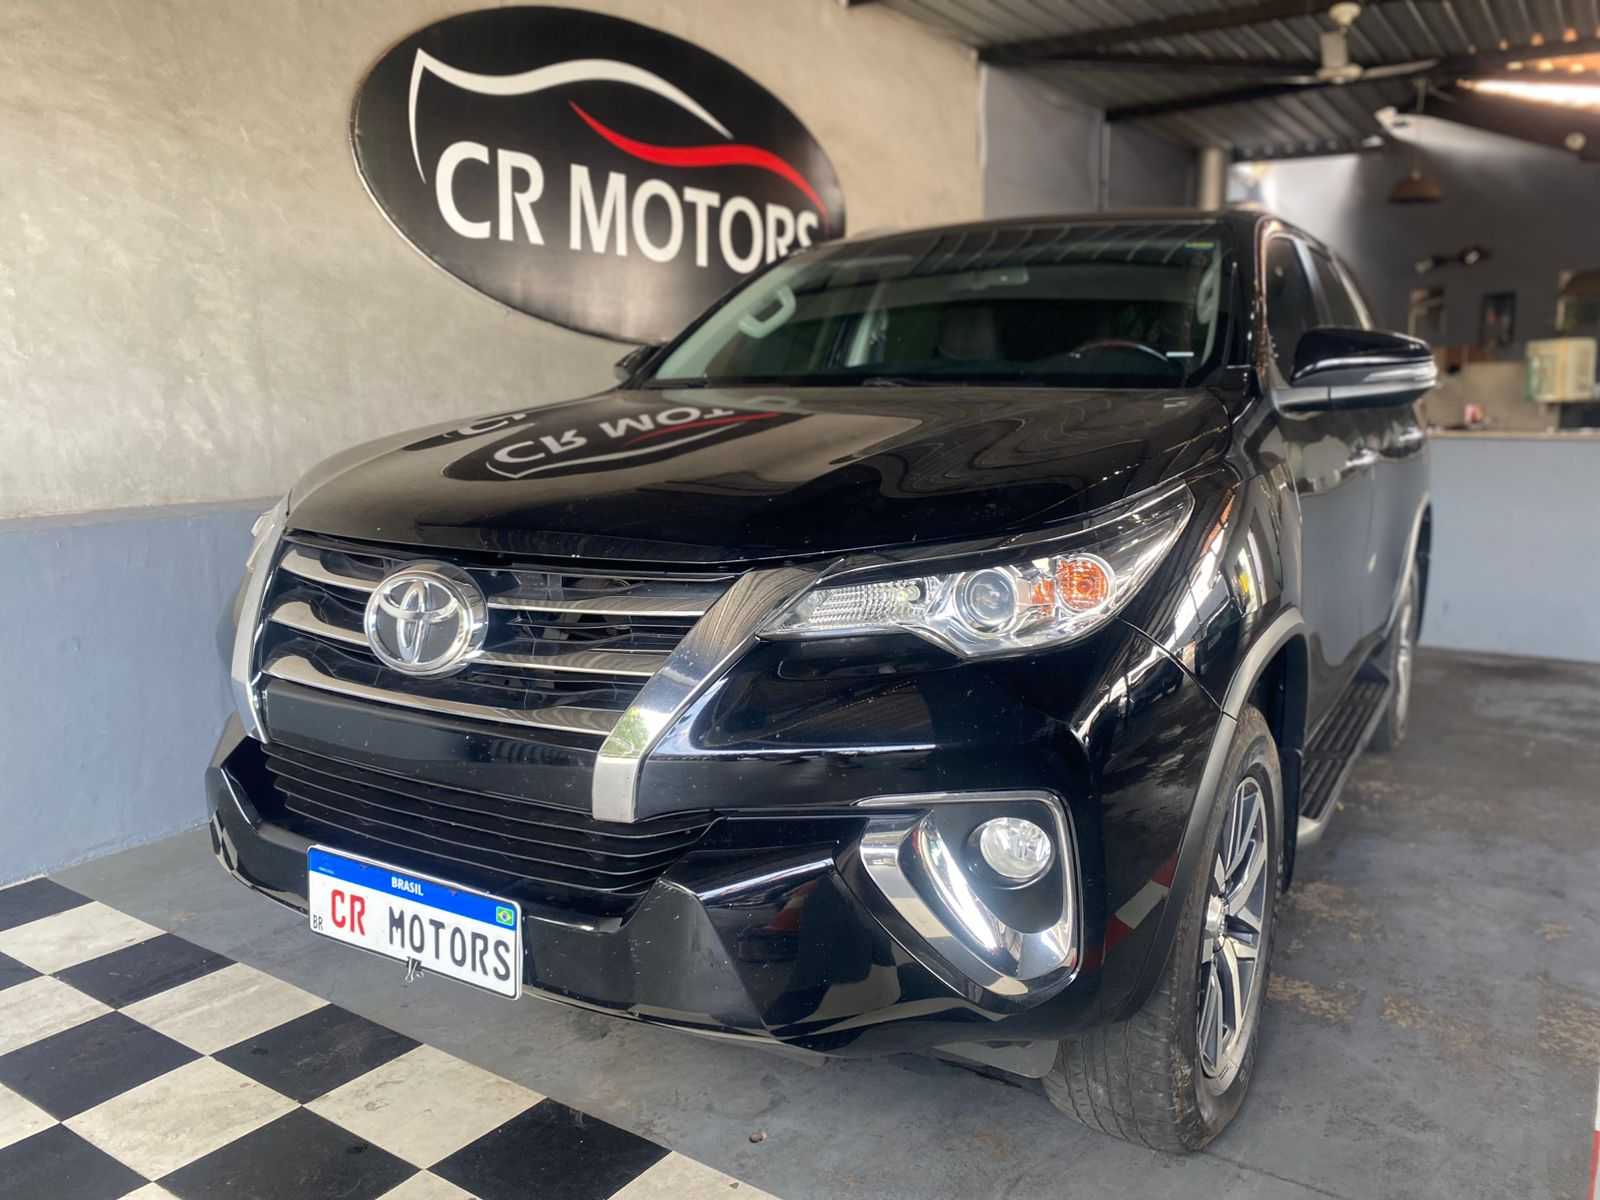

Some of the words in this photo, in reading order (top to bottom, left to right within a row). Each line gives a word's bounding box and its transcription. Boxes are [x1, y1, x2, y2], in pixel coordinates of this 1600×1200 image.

[435, 141, 544, 246] CR
[391, 876, 424, 896] BRASIL
[313, 914, 323, 931] BR
[331, 889, 366, 936] CR
[389, 905, 511, 982] MOTORS
